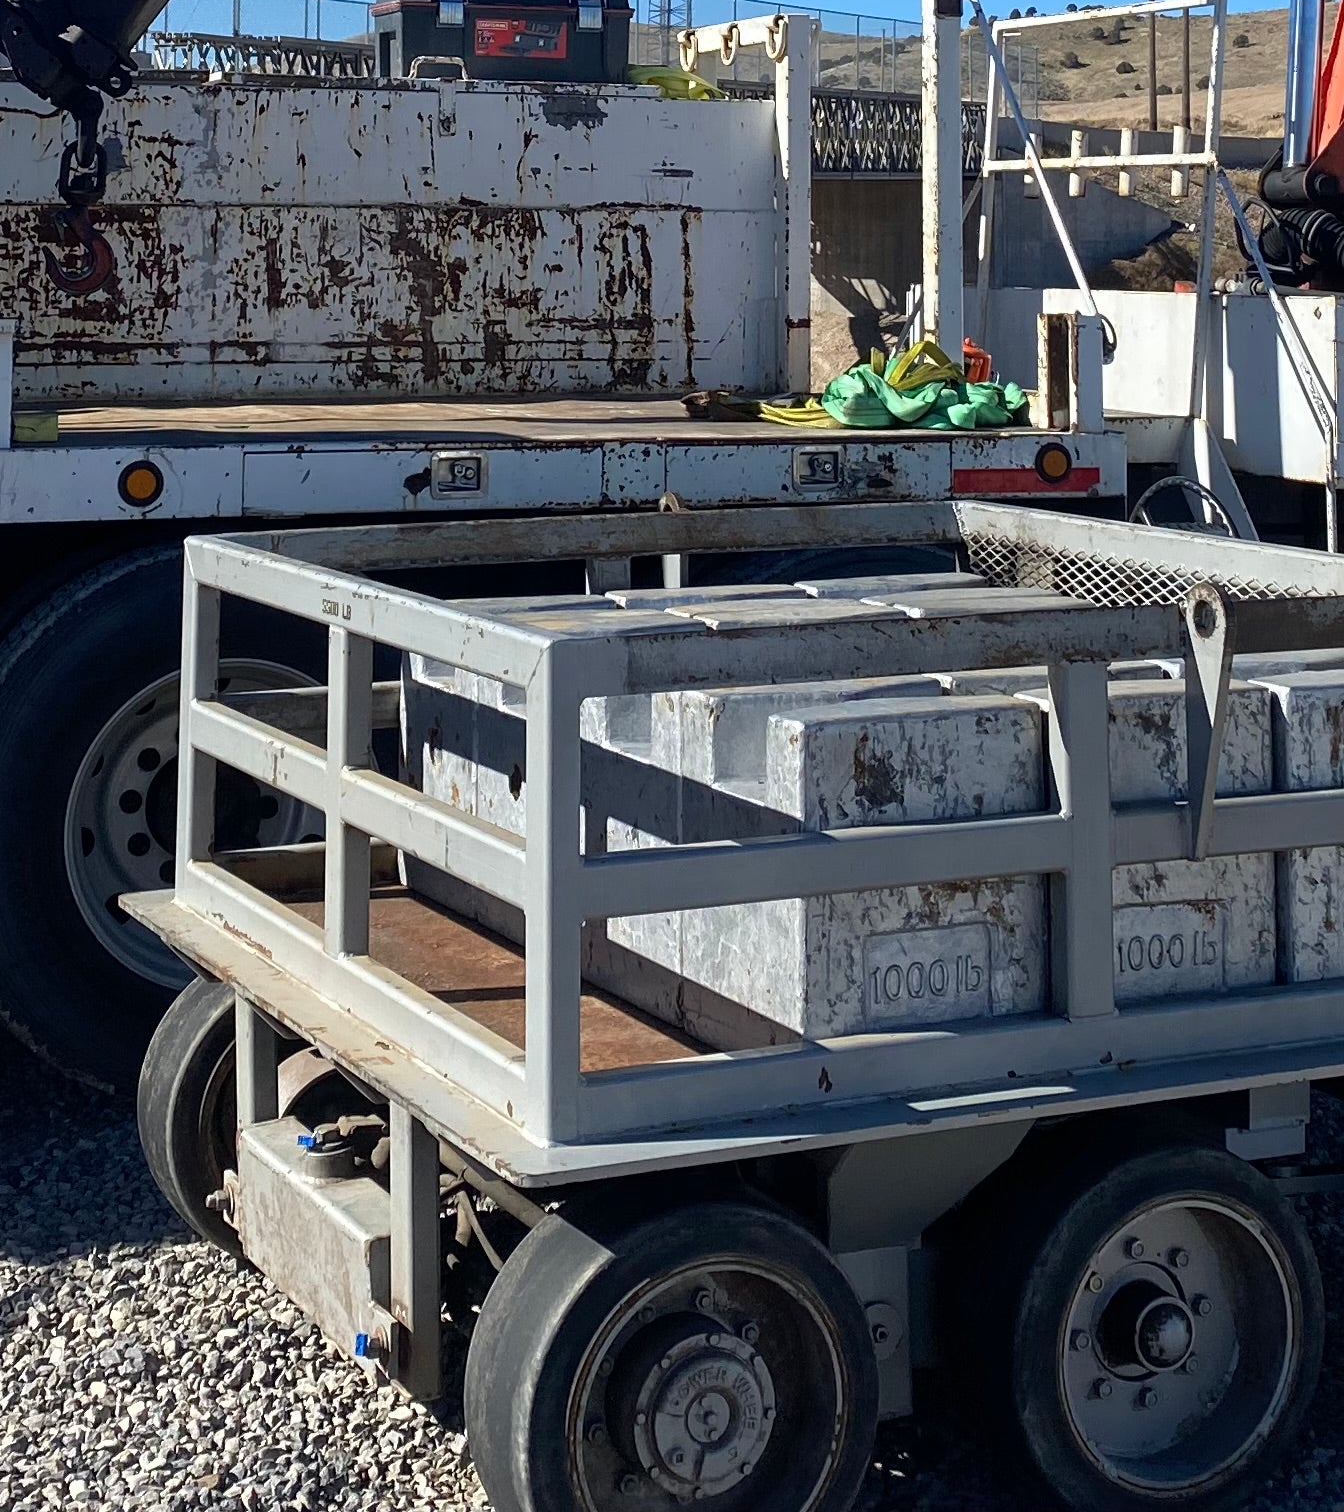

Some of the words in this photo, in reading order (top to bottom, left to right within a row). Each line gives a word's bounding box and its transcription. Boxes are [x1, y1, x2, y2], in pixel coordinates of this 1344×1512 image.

[1117, 933, 1185, 973] 1000
[1193, 929, 1218, 966] lb
[870, 958, 950, 1005] 1000
[956, 953, 984, 993] lb
